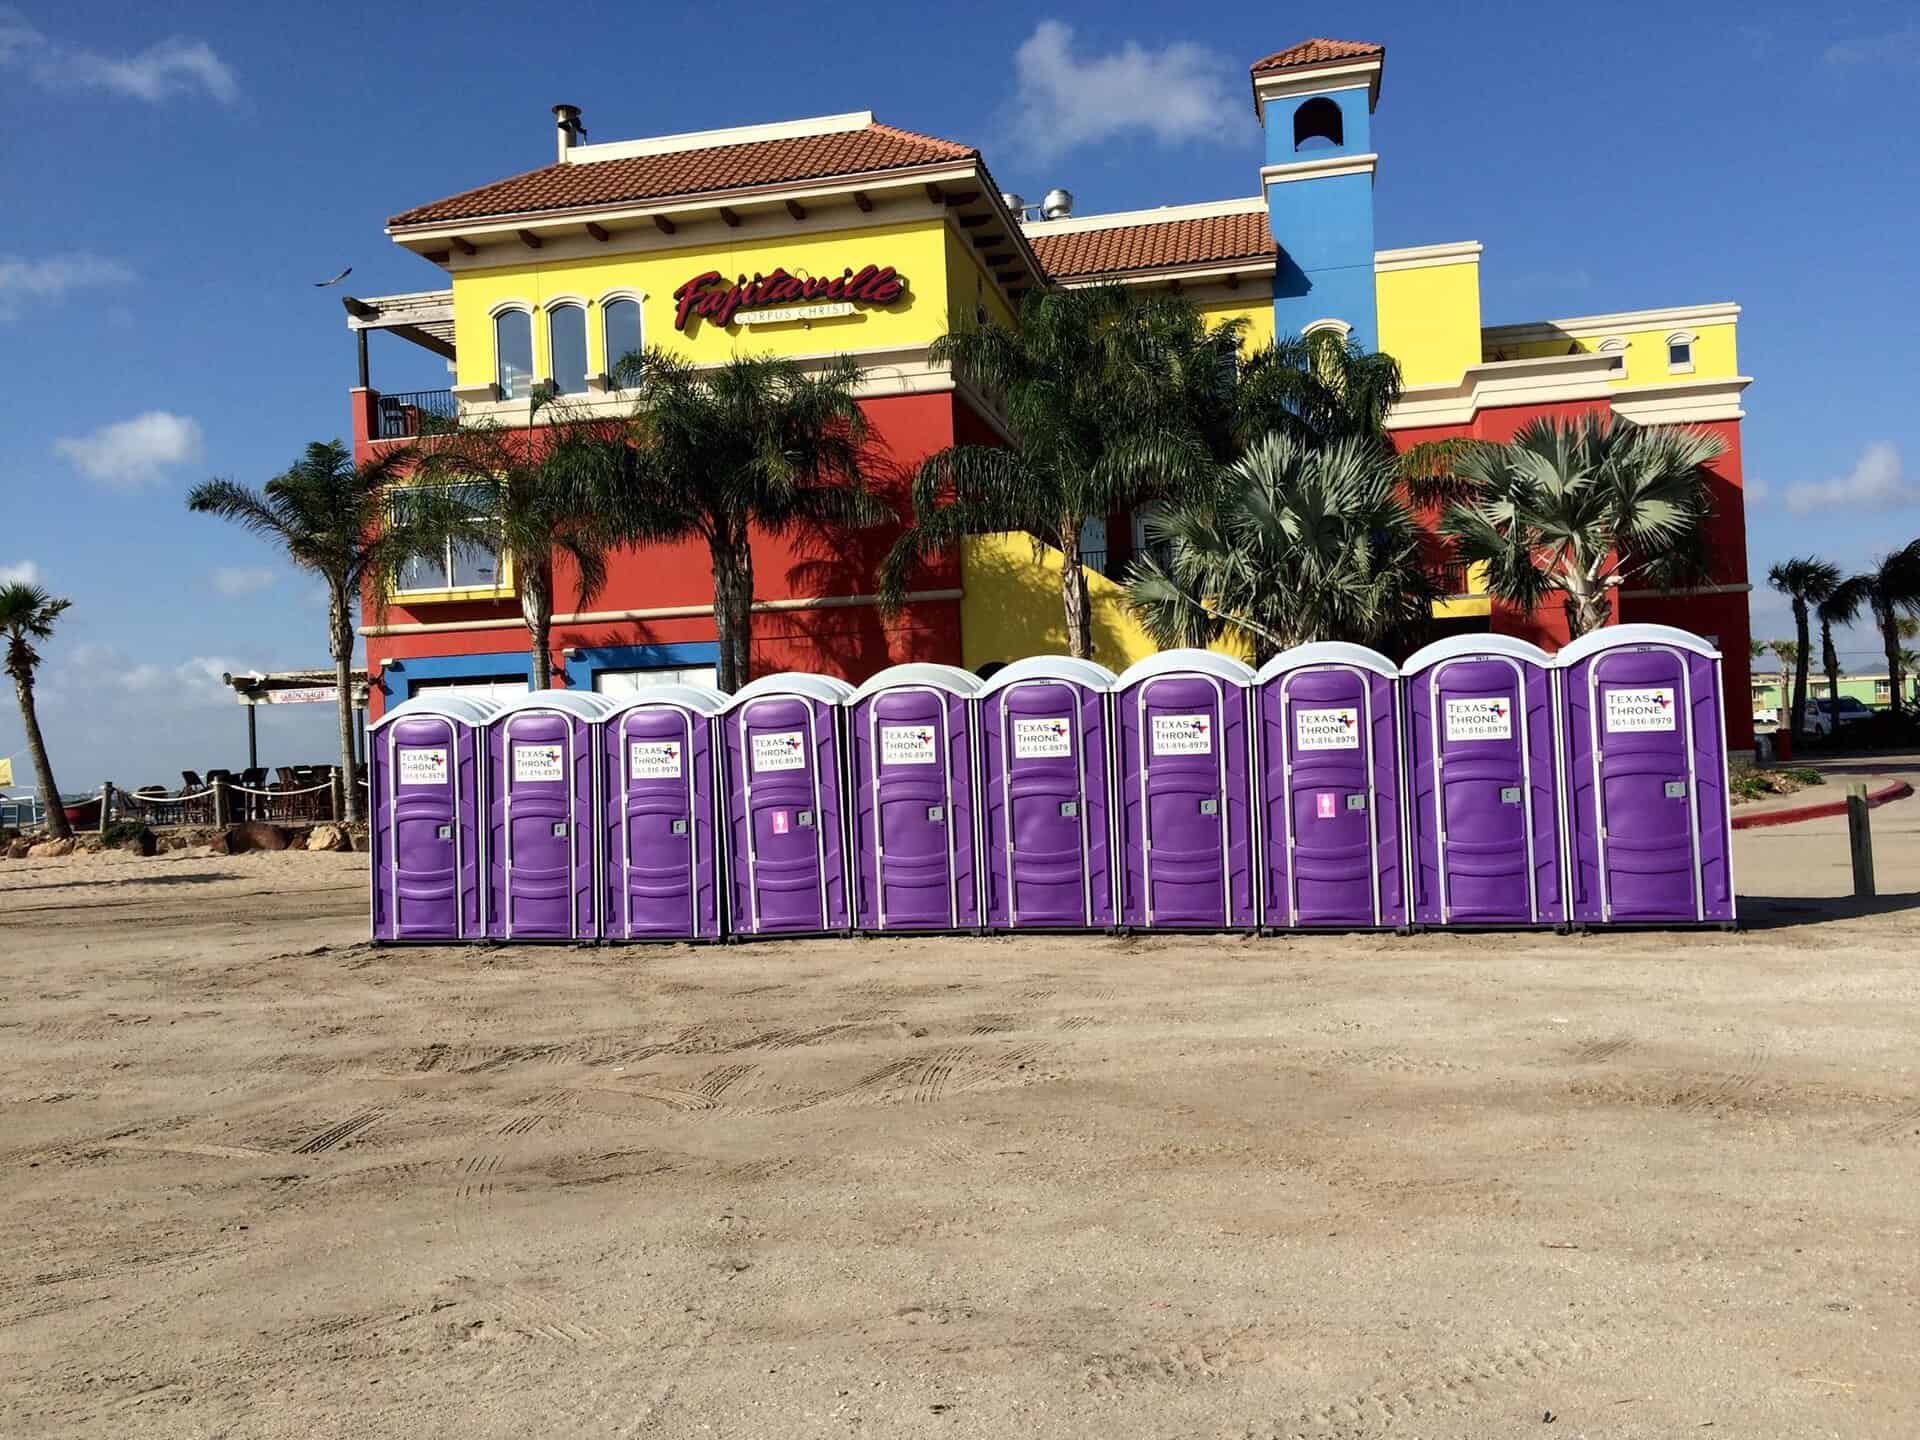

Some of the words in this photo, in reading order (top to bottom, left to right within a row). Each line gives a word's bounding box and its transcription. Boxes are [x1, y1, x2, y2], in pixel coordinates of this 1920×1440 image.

[673, 263, 904, 331] Fajitaville
[737, 311, 792, 323] CORPUS
[798, 303, 852, 318] CHRISTI
